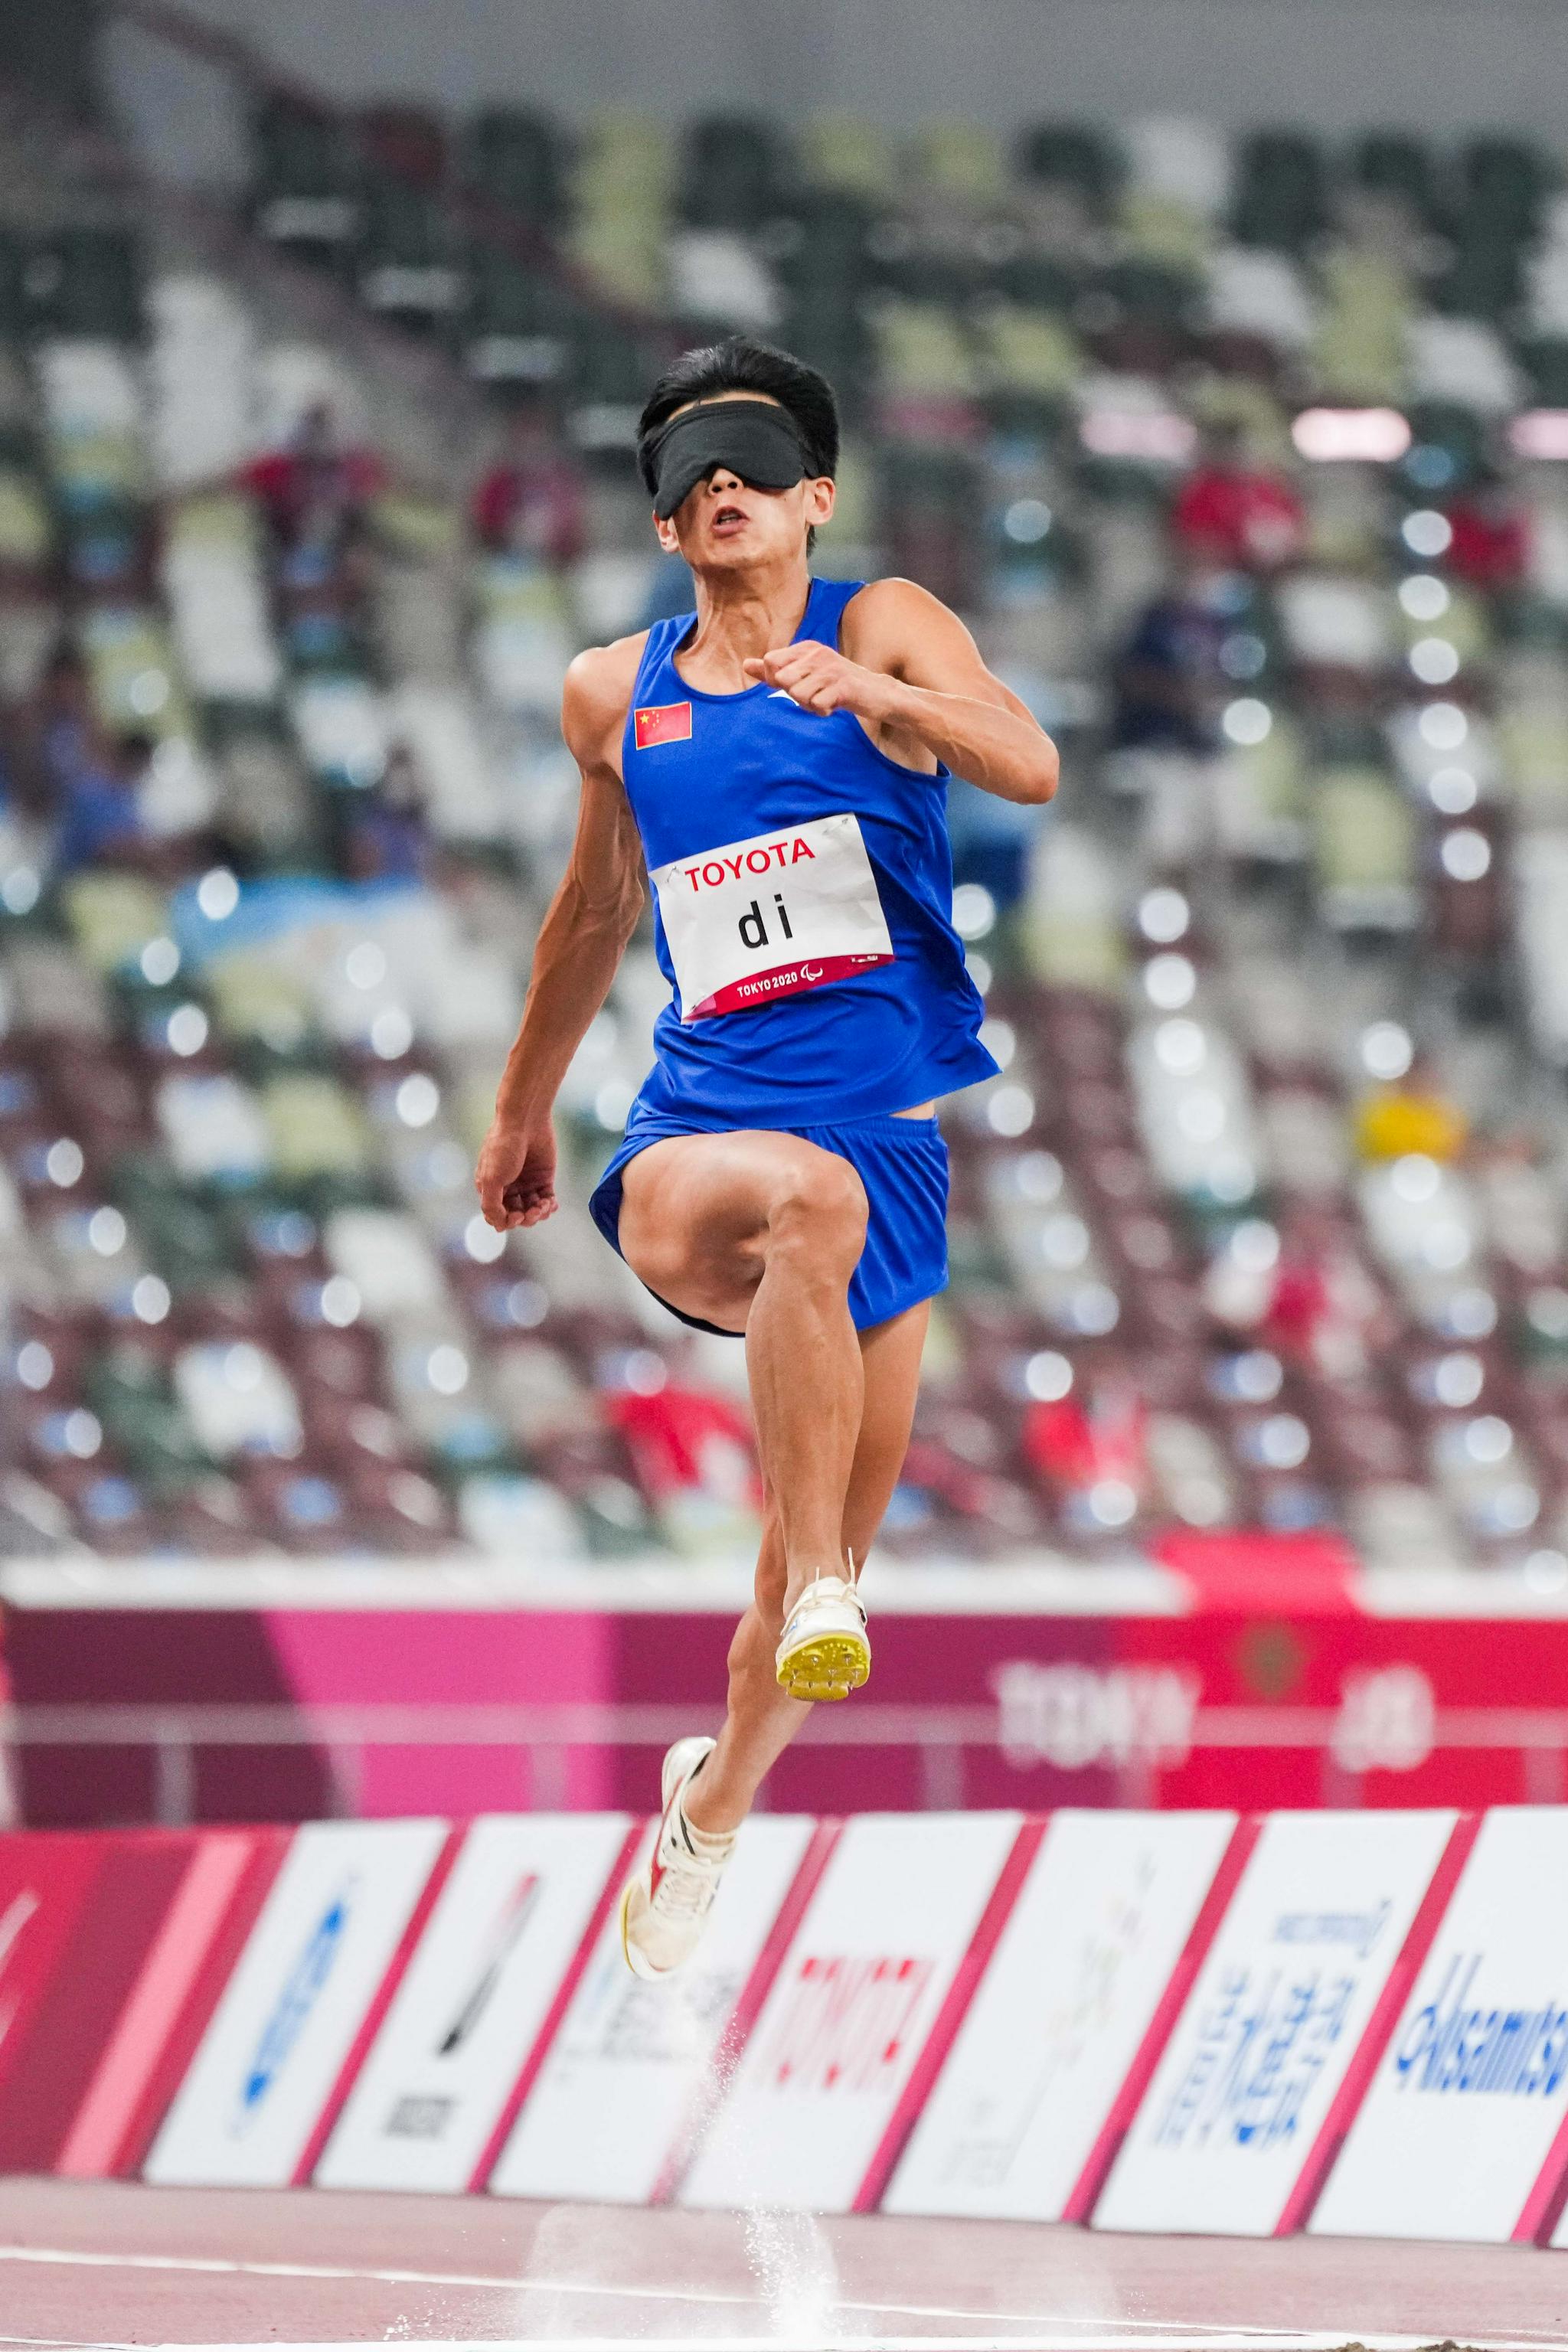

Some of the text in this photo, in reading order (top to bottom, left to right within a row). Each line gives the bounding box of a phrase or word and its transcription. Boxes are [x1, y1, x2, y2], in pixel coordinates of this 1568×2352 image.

[684, 838, 815, 891] TOYOTA
[737, 972, 798, 998] TOKYO 2020
